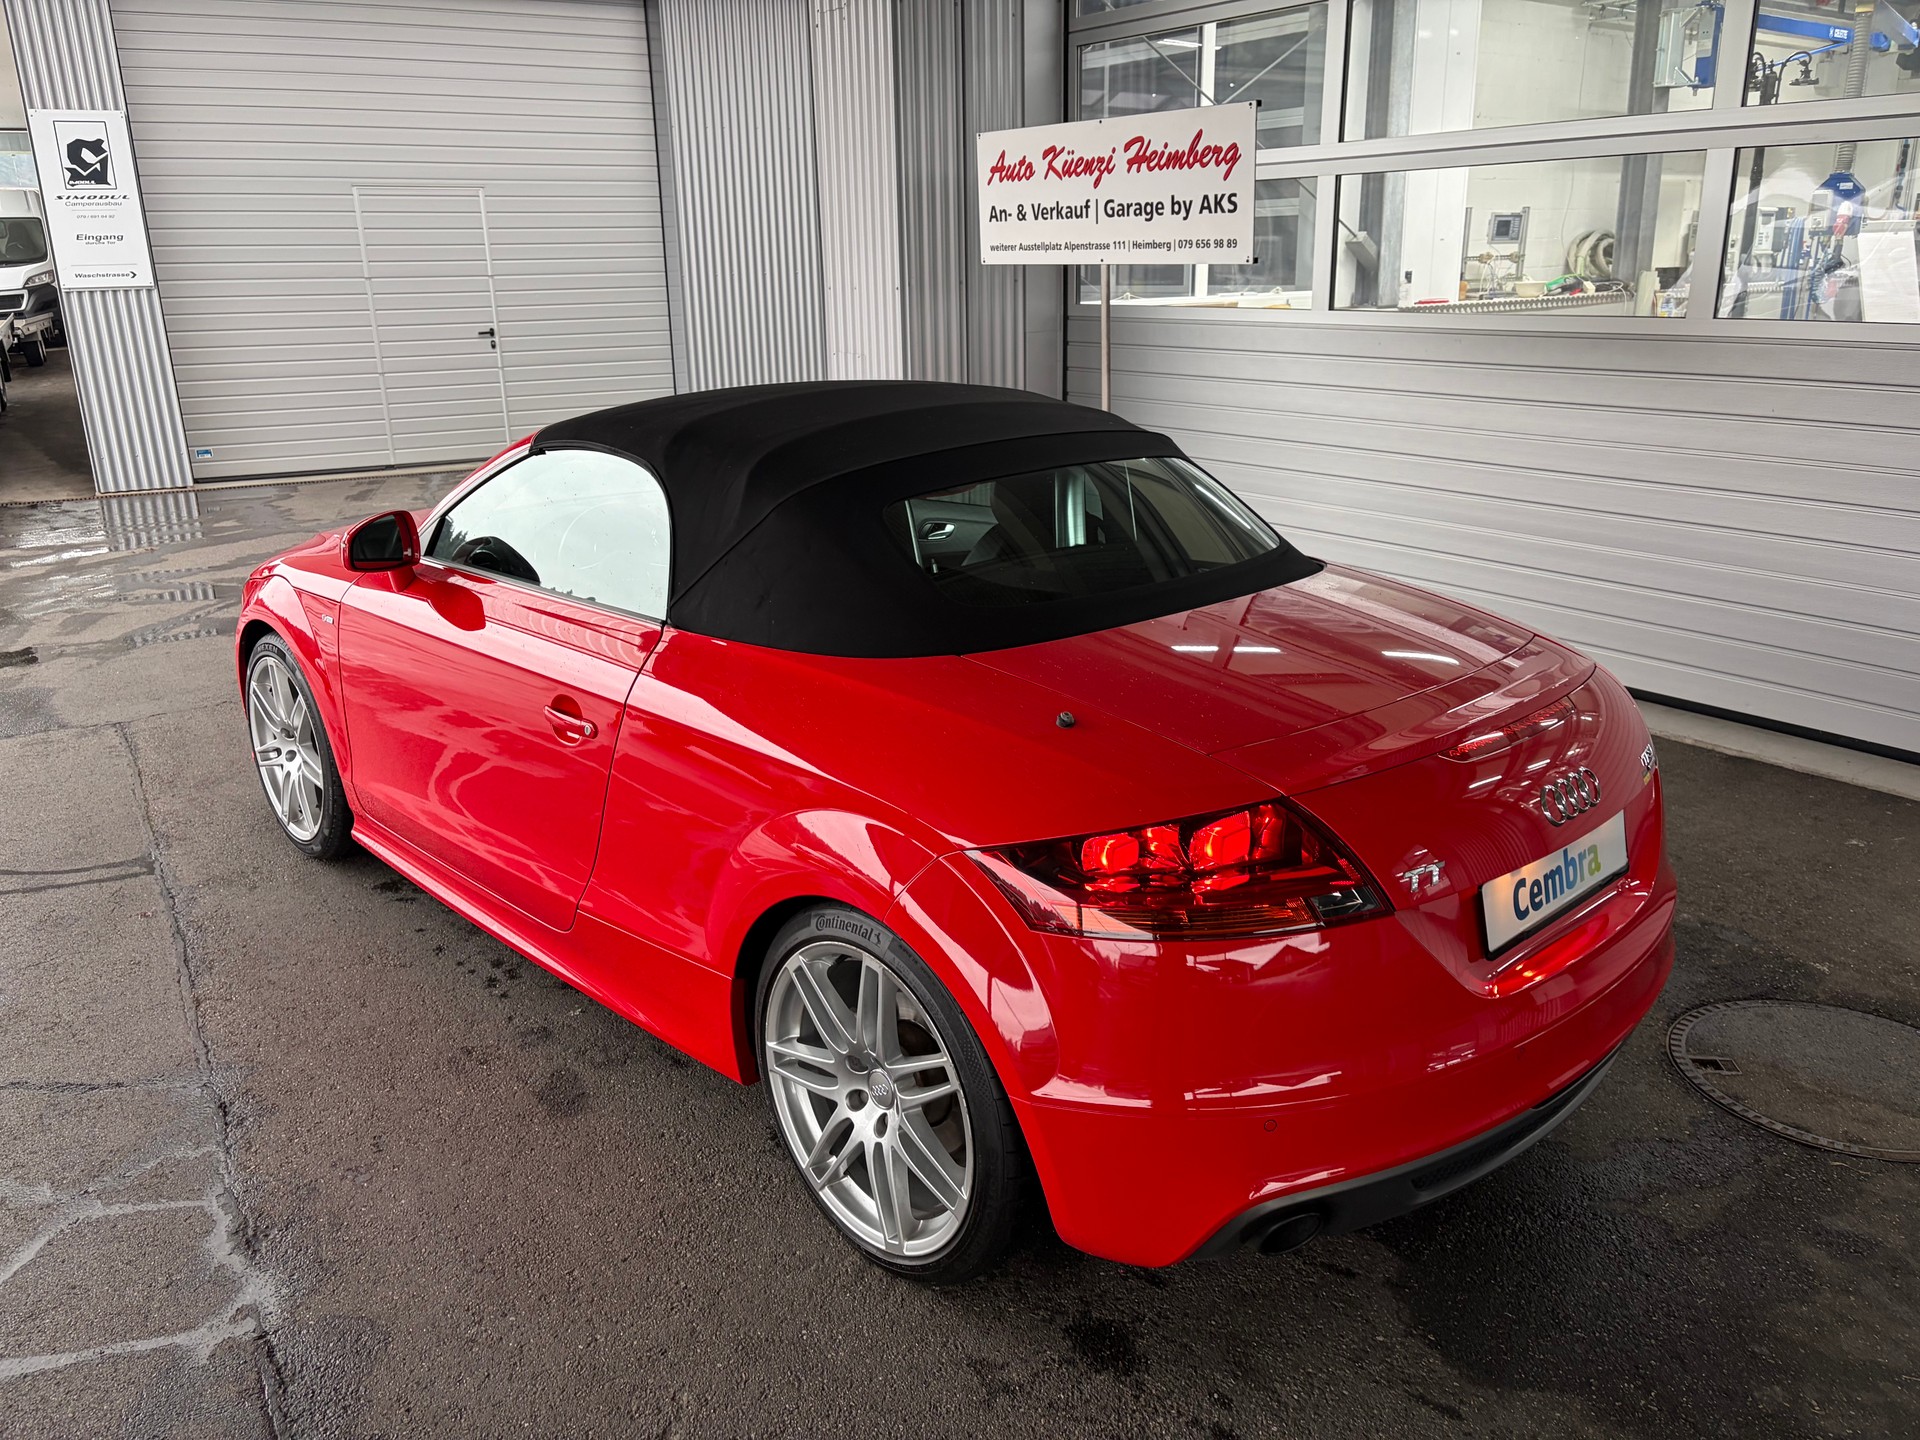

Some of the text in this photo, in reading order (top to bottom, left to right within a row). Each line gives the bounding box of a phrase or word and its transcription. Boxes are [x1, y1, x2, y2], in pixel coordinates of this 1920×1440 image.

[987, 128, 1242, 189] Auto Küenzi Heimberg
[989, 204, 1012, 223] An-
[1016, 203, 1027, 221] &
[1031, 198, 1091, 221] Verkauf
[1103, 198, 1165, 222] Garage
[1170, 194, 1193, 221] by
[1199, 192, 1238, 214] AKS
[76, 233, 124, 242] Eingang
[989, 241, 1017, 252] weiterer
[1018, 240, 1062, 253] Ausstellplatz
[1064, 240, 1111, 253] Alpenstrasse
[1113, 240, 1126, 250] 111
[1132, 239, 1172, 252] Heimberg
[1178, 239, 1194, 249] 079
[1195, 238, 1212, 249] 656
[1213, 238, 1225, 249] 98
[1226, 238, 1238, 249] 89
[257, 643, 278, 654] NEXEN
[1403, 859, 1445, 893] TT
[1512, 844, 1602, 921] Cembra
[815, 914, 874, 942] Continental
